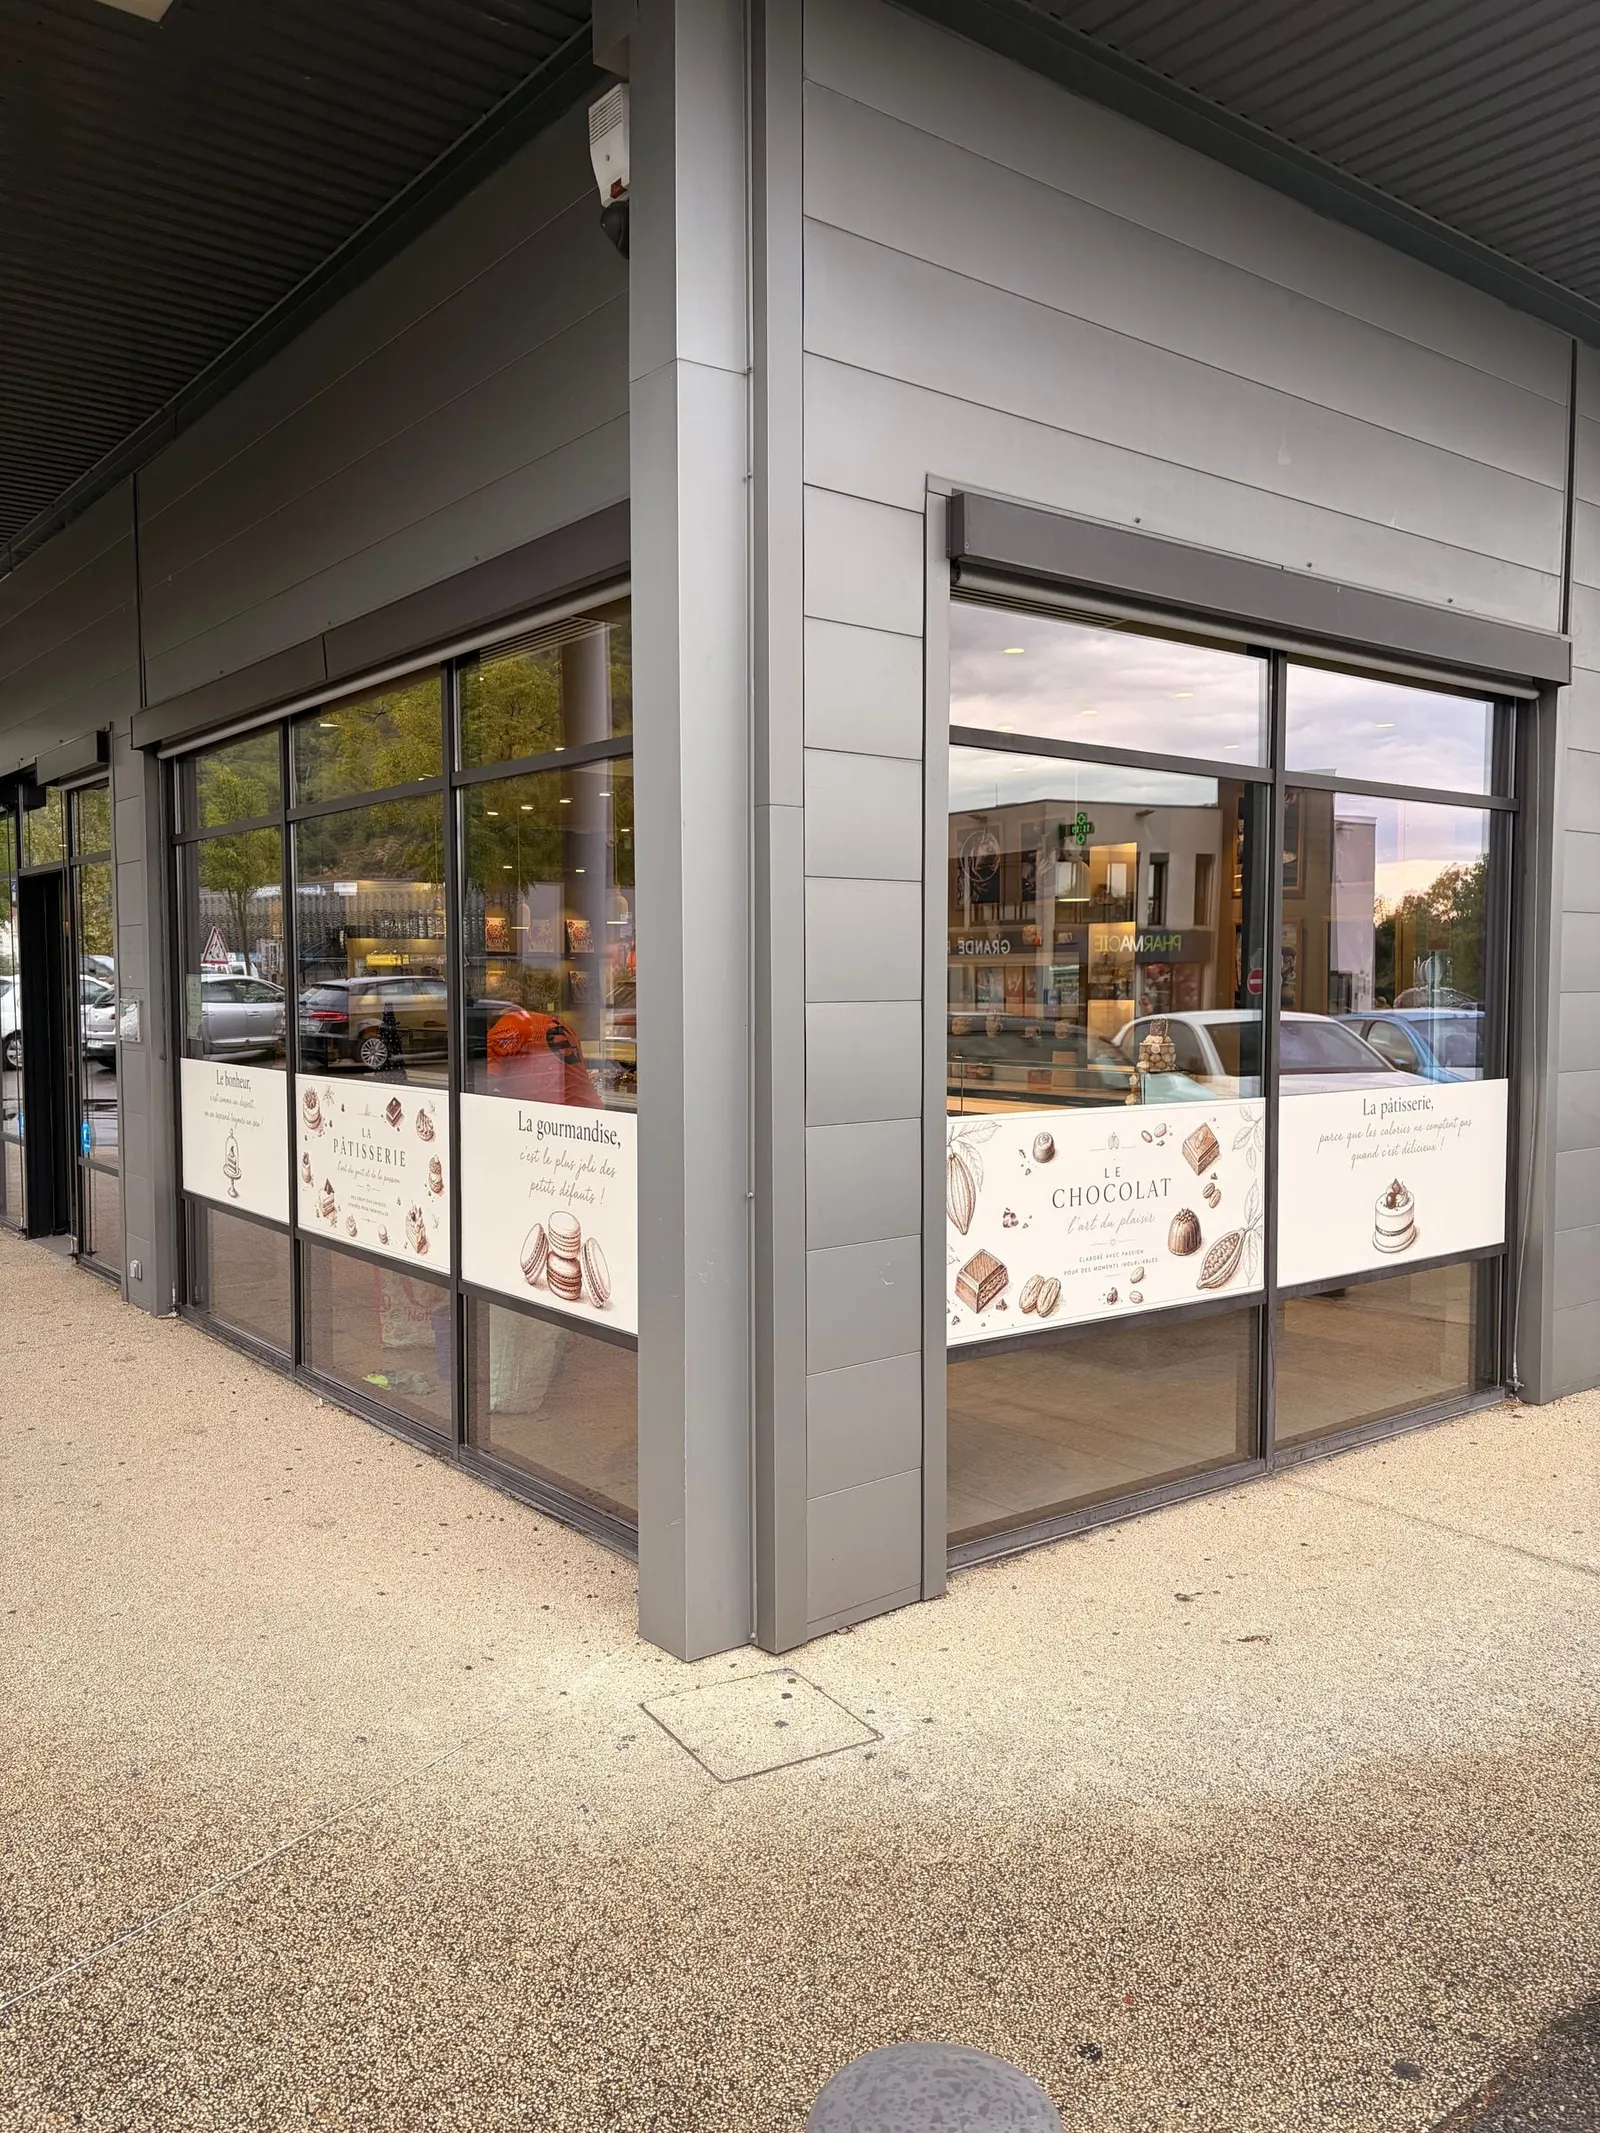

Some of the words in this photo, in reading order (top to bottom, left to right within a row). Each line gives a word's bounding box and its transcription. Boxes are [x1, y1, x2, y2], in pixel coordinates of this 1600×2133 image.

[216, 1069, 224, 1085] Le
[224, 1070, 252, 1092] bonheur,
[1363, 1098, 1376, 1116] La
[1380, 1095, 1434, 1120] pâtisserie,
[361, 1127, 372, 1139] LA
[518, 1110, 533, 1132] La
[536, 1119, 621, 1149] gourmandise,
[1317, 1133, 1344, 1154] parce
[1346, 1131, 1363, 1148] que
[1365, 1123, 1377, 1138] les
[1379, 1120, 1411, 1136] calories
[1413, 1124, 1424, 1133] ne
[1425, 1116, 1459, 1138] comptent
[1457, 1118, 1472, 1137] pas
[333, 1136, 406, 1167] PÂTISSERIE
[519, 1145, 540, 1163] c'est
[543, 1147, 553, 1165] le
[553, 1149, 575, 1175] plus
[574, 1154, 597, 1181] joli
[599, 1158, 617, 1178] des
[1350, 1144, 1380, 1170] quand
[1381, 1142, 1401, 1158] c'est
[1401, 1138, 1437, 1155] délicieux
[1104, 1166, 1121, 1179] LE
[528, 1176, 557, 1198] petits
[559, 1180, 596, 1207] défauts
[1052, 1178, 1172, 1209] CHOCOLAT
[1067, 1213, 1098, 1235] l'art
[1100, 1212, 1115, 1229] du
[1115, 1208, 1156, 1234] plaisir
[1105, 1252, 1120, 1260] AVEC
[1121, 1249, 1144, 1257] PASSION
[1063, 1268, 1079, 1276] POUR
[1093, 1263, 1120, 1272] MOMENTS
